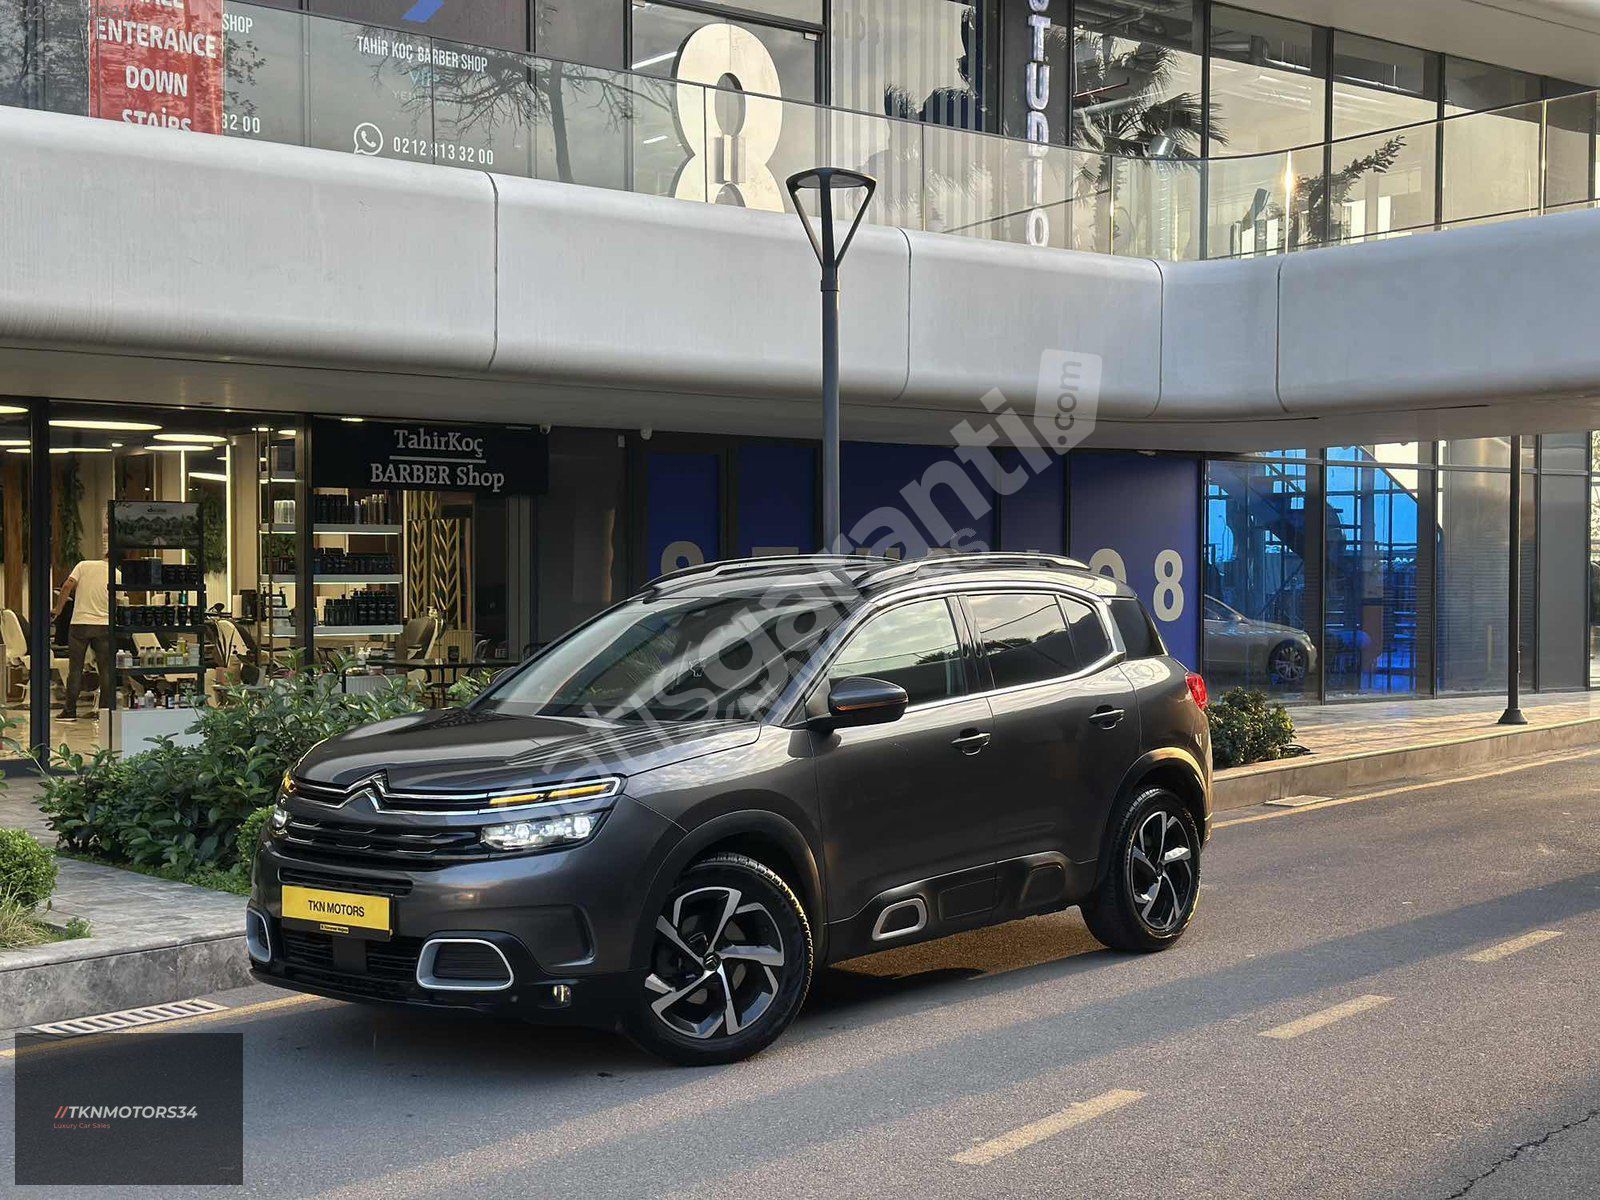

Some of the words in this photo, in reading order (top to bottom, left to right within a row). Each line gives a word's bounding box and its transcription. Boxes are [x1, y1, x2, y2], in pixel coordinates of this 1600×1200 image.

[96, 17, 217, 59] ENTERANCE
[222, 13, 253, 34] SHOP
[391, 41, 413, 63] KOÇ
[417, 46, 459, 69] BARBER
[461, 53, 488, 73] SHOP
[125, 65, 188, 97] DOWN
[242, 115, 261, 134] 00
[1026, 0, 1051, 247] TUDIO
[393, 136, 427, 156] 0212
[459, 146, 475, 163] 32
[478, 148, 494, 165] 00
[393, 428, 484, 458] TahirKoç
[370, 463, 451, 486] BARBER
[456, 465, 505, 493] Shop
[307, 899, 326, 913] TKN
[327, 901, 365, 918] MOTORS
